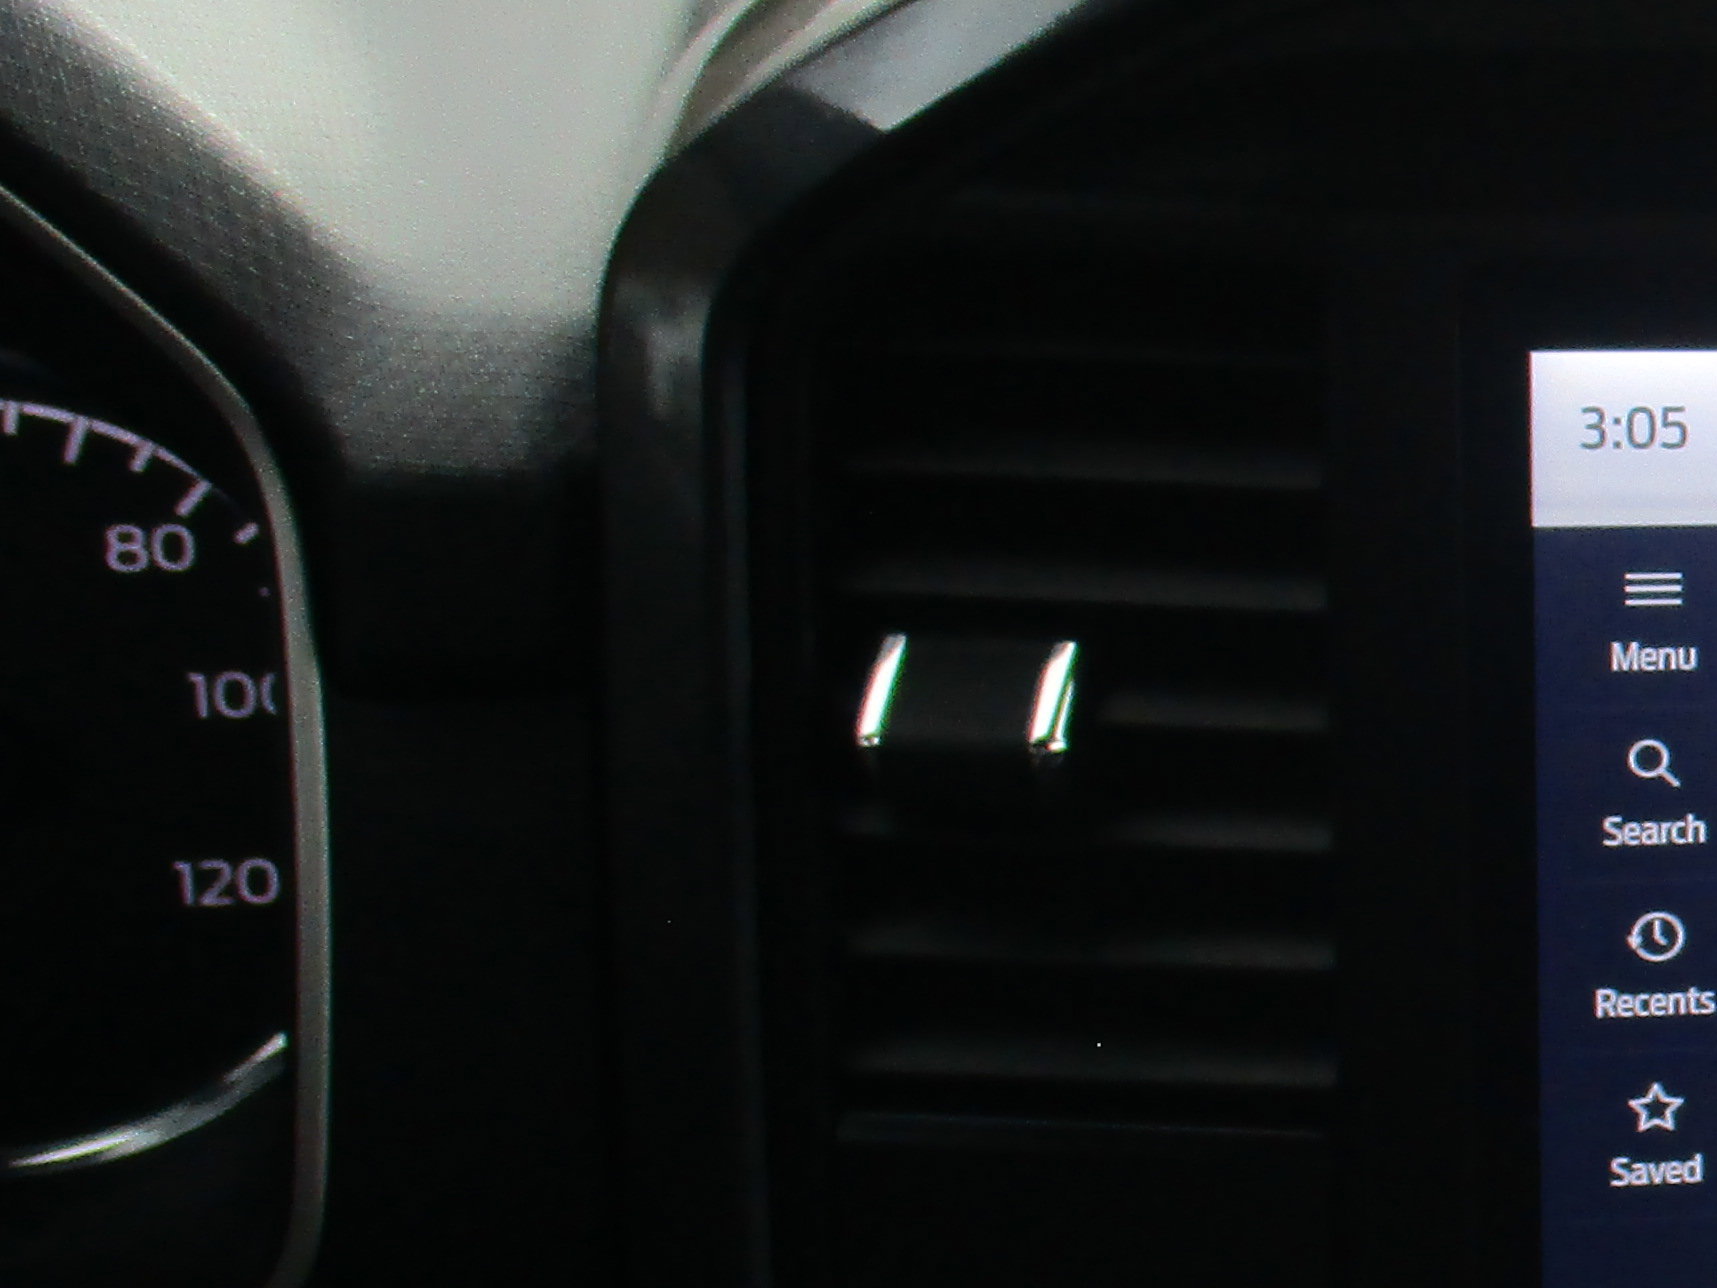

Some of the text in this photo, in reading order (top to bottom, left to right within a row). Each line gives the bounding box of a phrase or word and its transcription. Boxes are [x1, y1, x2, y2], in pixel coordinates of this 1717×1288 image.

[1580, 404, 1689, 451] 3:05
[104, 523, 196, 573] 80
[1611, 641, 1698, 673] Menu
[1602, 813, 1706, 848] Search
[174, 858, 280, 907] 120
[1596, 985, 1716, 1019] Recents
[1610, 1153, 1703, 1188] Saved
